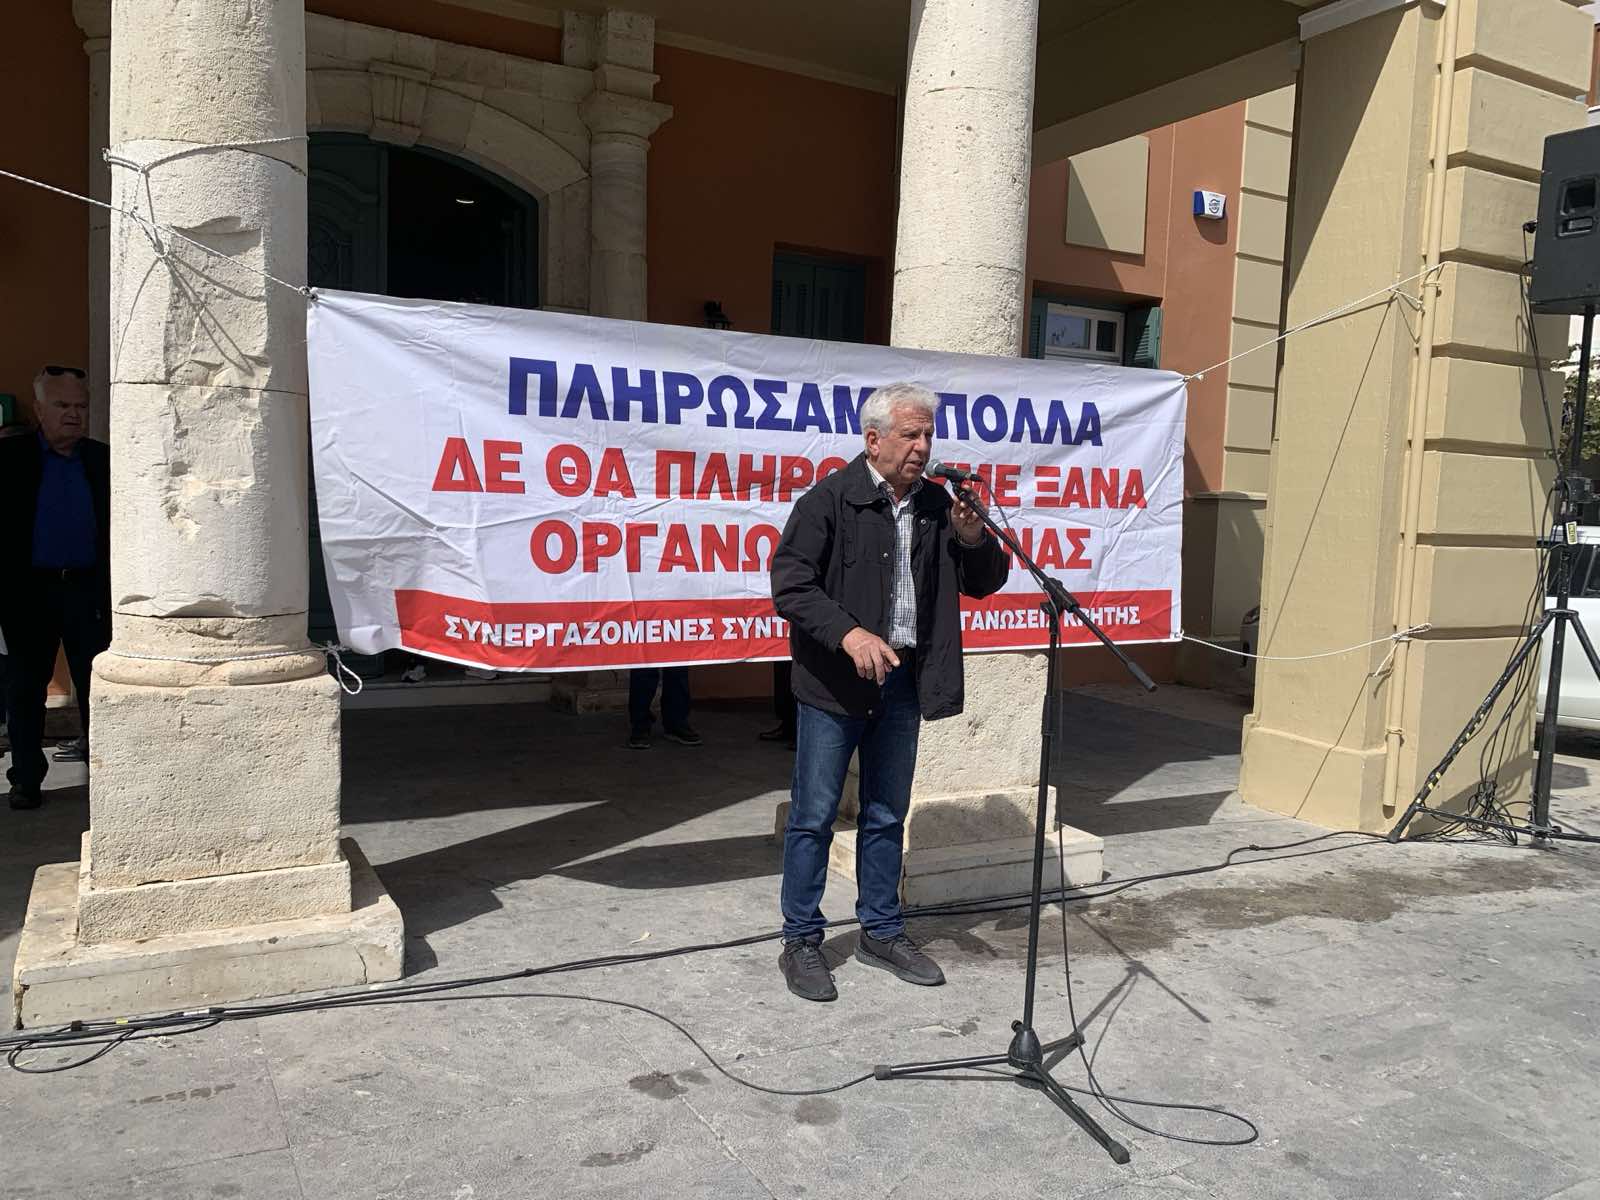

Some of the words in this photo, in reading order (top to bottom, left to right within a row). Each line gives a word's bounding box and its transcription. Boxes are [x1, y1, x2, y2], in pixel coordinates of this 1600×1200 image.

[508, 357, 877, 435] ΠΛΗΡΩΣΑΜ
[934, 392, 1103, 446] ΠΟΛΛΑ
[432, 437, 525, 494] ΔΕ
[545, 444, 636, 499] ΘΑ
[1034, 465, 1147, 509] ΞΑΝΑ
[530, 519, 783, 573] ΟΡΓΑΝΩ
[985, 527, 1092, 570] ΝΑΣ
[444, 614, 715, 647] ΣΥΝΕΡΓΑΖΟΜΕΝΕΣ
[721, 616, 790, 640] ΣΥΝΤ
[960, 608, 1050, 631] ΓΑΝΩΣΕΙ
